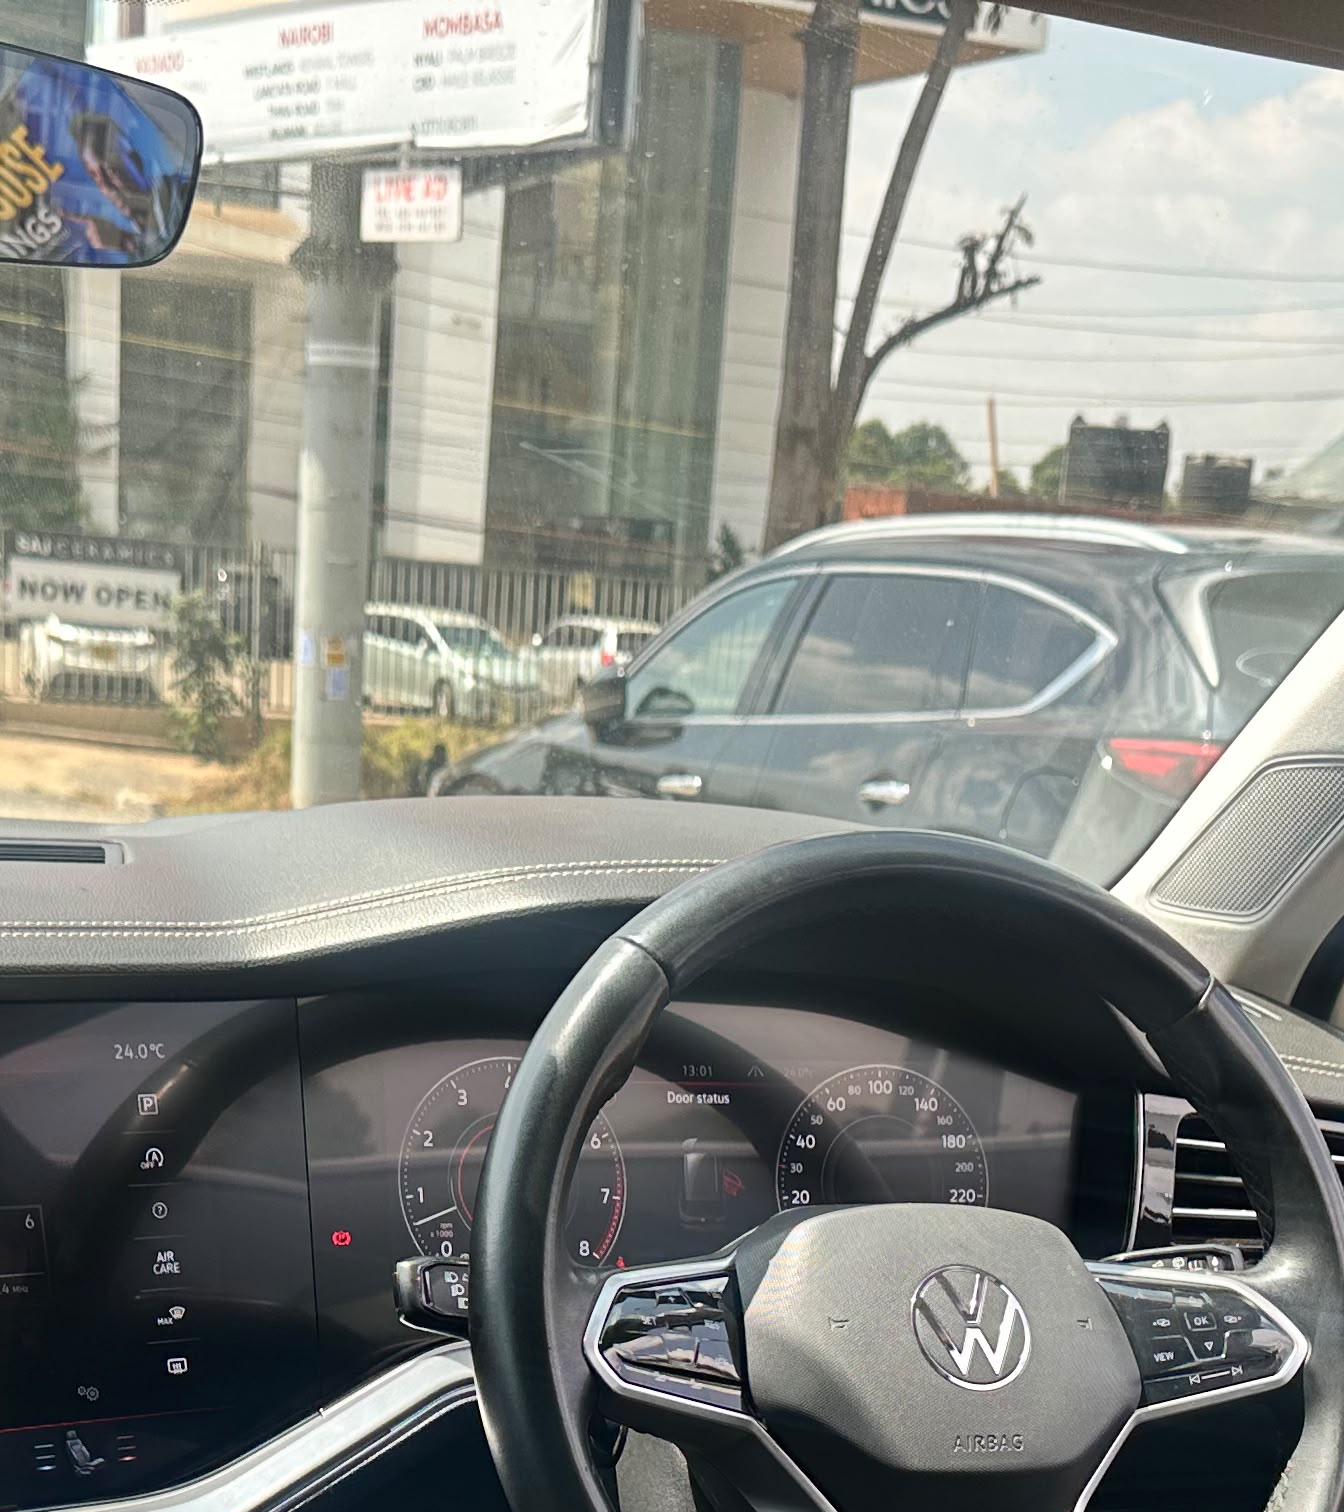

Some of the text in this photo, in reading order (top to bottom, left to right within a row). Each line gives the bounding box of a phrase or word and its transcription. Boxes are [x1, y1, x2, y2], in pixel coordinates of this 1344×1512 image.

[423, 11, 503, 38] MOMBASA
[19, 577, 173, 612] NOW OPEN
[682, 1064, 713, 1076] 13:01
[848, 1085, 861, 1096] 80
[868, 1080, 893, 1094] 100
[898, 1086, 914, 1096] 120
[458, 1090, 468, 1106] 3
[667, 1090, 730, 1104] Door status
[826, 1097, 846, 1112] 60
[914, 1097, 938, 1112] 140
[810, 1115, 824, 1126] 50
[936, 1115, 953, 1126] 160
[423, 1130, 434, 1147] 2
[590, 1133, 602, 1150] 6
[796, 1134, 816, 1149] 40
[941, 1134, 966, 1148] 180
[790, 1162, 804, 1174] 30
[955, 1162, 974, 1172] 200
[416, 1187, 424, 1203] 1
[600, 1188, 610, 1204] 7
[791, 1189, 810, 1204] 20
[950, 1188, 976, 1204] 220
[24, 1214, 35, 1229] 6
[156, 1250, 174, 1262] AIR
[440, 1240, 452, 1257] 0
[579, 1240, 590, 1257] 8
[152, 1262, 181, 1275] CARE
[1194, 1316, 1210, 1326] OK
[1154, 1352, 1174, 1362] VIEW
[953, 1433, 1025, 1453] AIRBAG
